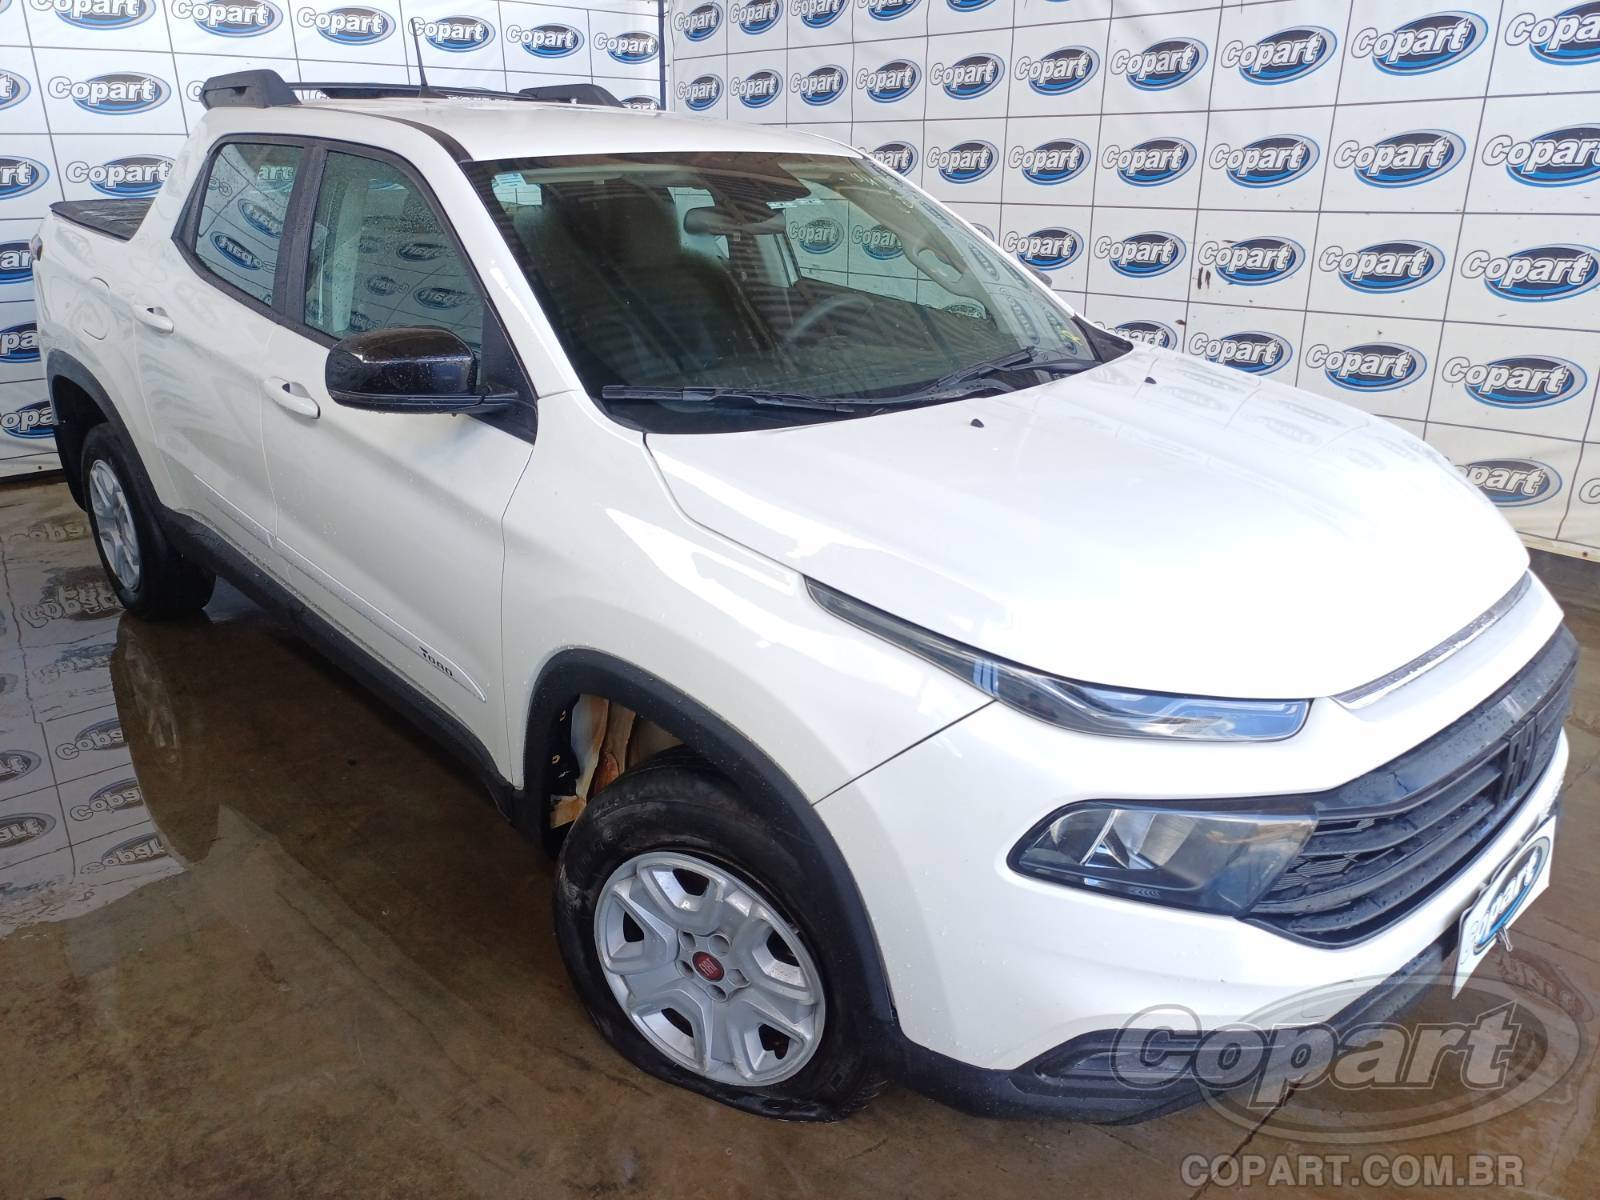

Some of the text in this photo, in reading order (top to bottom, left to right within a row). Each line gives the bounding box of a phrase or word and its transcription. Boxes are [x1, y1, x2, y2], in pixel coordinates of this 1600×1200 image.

[171, 0, 271, 27] Copart
[297, 7, 384, 35] Copart
[674, 8, 718, 31] Copart
[730, 0, 777, 25] Copart
[408, 17, 485, 42] Copart
[506, 24, 575, 49] Copart
[594, 32, 656, 55] Copart
[1351, 16, 1471, 64] Copart
[1505, 12, 1600, 52] Copa
[1015, 50, 1092, 84] Copart
[1111, 43, 1195, 81] Copart
[1221, 32, 1322, 73] Copart
[730, 74, 777, 99] Copart
[790, 69, 842, 96] Copart
[855, 64, 913, 90] Copart
[929, 58, 995, 89] Copart
[48, 75, 155, 105] Copart
[676, 76, 719, 102] Copart
[926, 146, 990, 174] Copart
[1008, 143, 1081, 175] Copart
[1102, 142, 1188, 177] Copart
[1209, 141, 1305, 176] Copart
[1334, 136, 1451, 177] Copart
[66, 160, 173, 188] Copart
[790, 220, 837, 247] Copart
[851, 224, 903, 249] Copar
[1003, 231, 1075, 261] Copart
[1094, 235, 1175, 264] Copart
[1197, 240, 1293, 273] Copart
[1319, 245, 1429, 280] Copart
[1460, 250, 1593, 288] Copart
[1189, 332, 1280, 366] Copart
[1305, 344, 1413, 378] Copart
[1442, 356, 1570, 394] Copart
